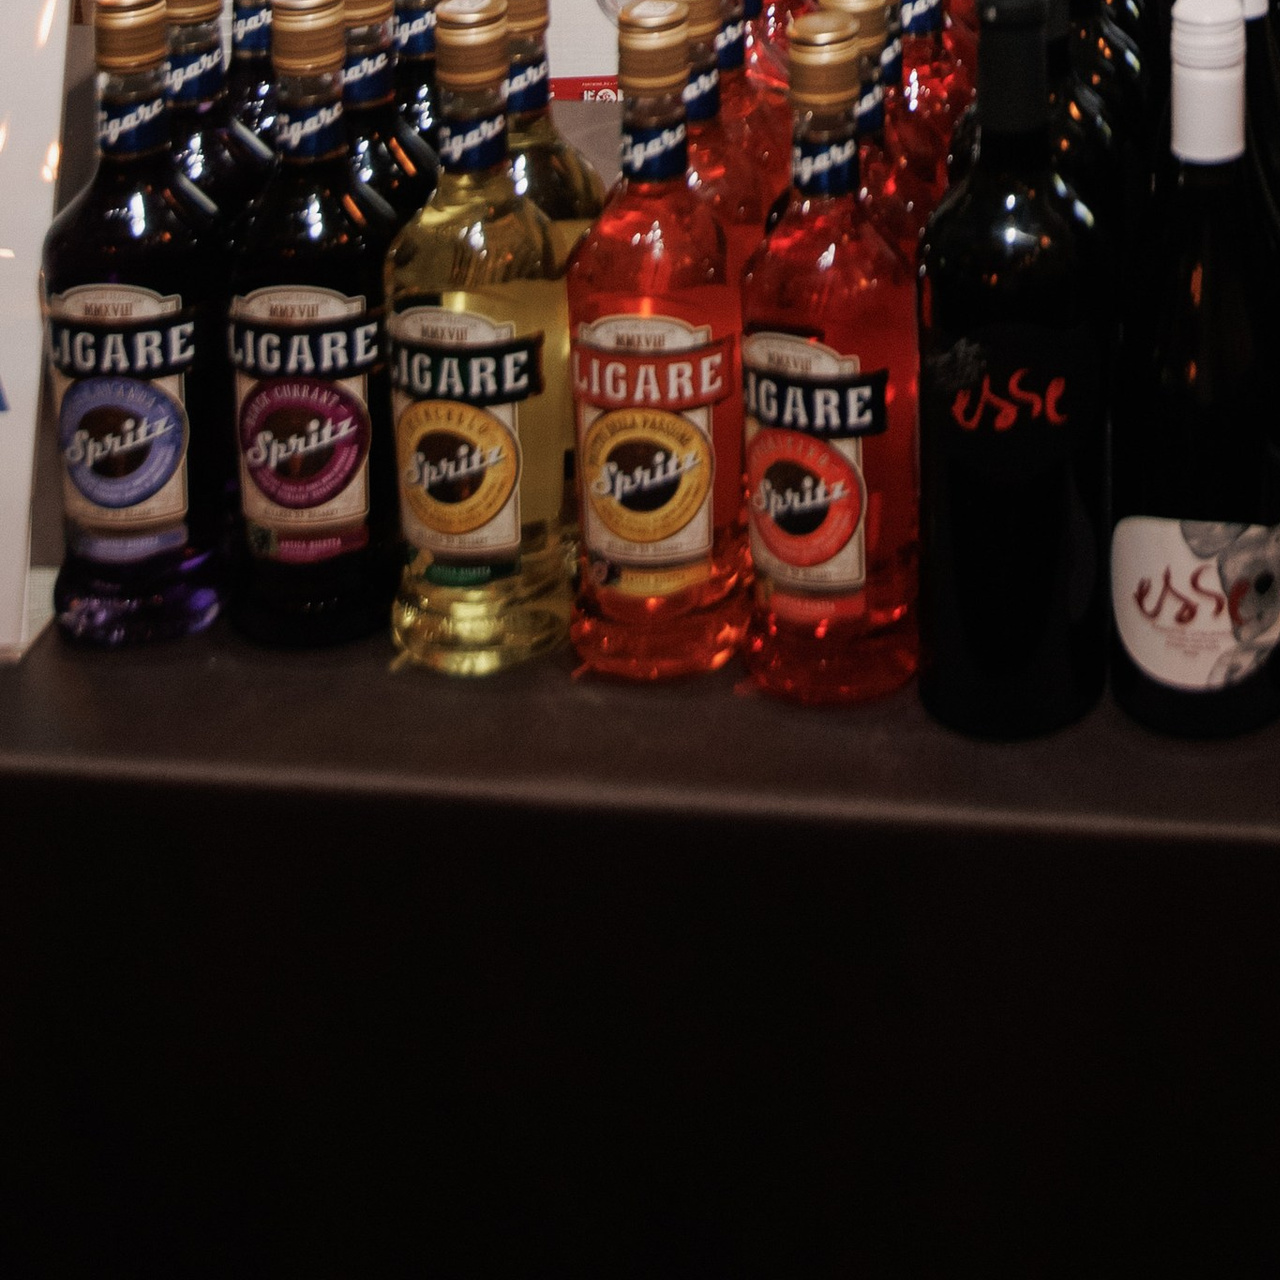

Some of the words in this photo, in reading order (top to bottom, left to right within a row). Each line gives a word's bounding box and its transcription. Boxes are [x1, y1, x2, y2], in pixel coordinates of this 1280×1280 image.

[163, 48, 222, 94] igare
[99, 98, 165, 145] igare
[440, 114, 505, 162] igare
[623, 124, 686, 171] igare
[229, 321, 378, 373] LIGARE
[275, 383, 340, 406] CURRANT
[573, 352, 723, 403] LIGARE
[747, 371, 873, 429] IGARE
[952, 368, 1068, 432] esse
[65, 415, 175, 466] Spritz
[246, 415, 358, 470] Spritz
[404, 443, 505, 490] Spritz
[590, 450, 701, 504] Spritz
[752, 474, 850, 519] Spritz
[1134, 563, 1251, 626] esse
